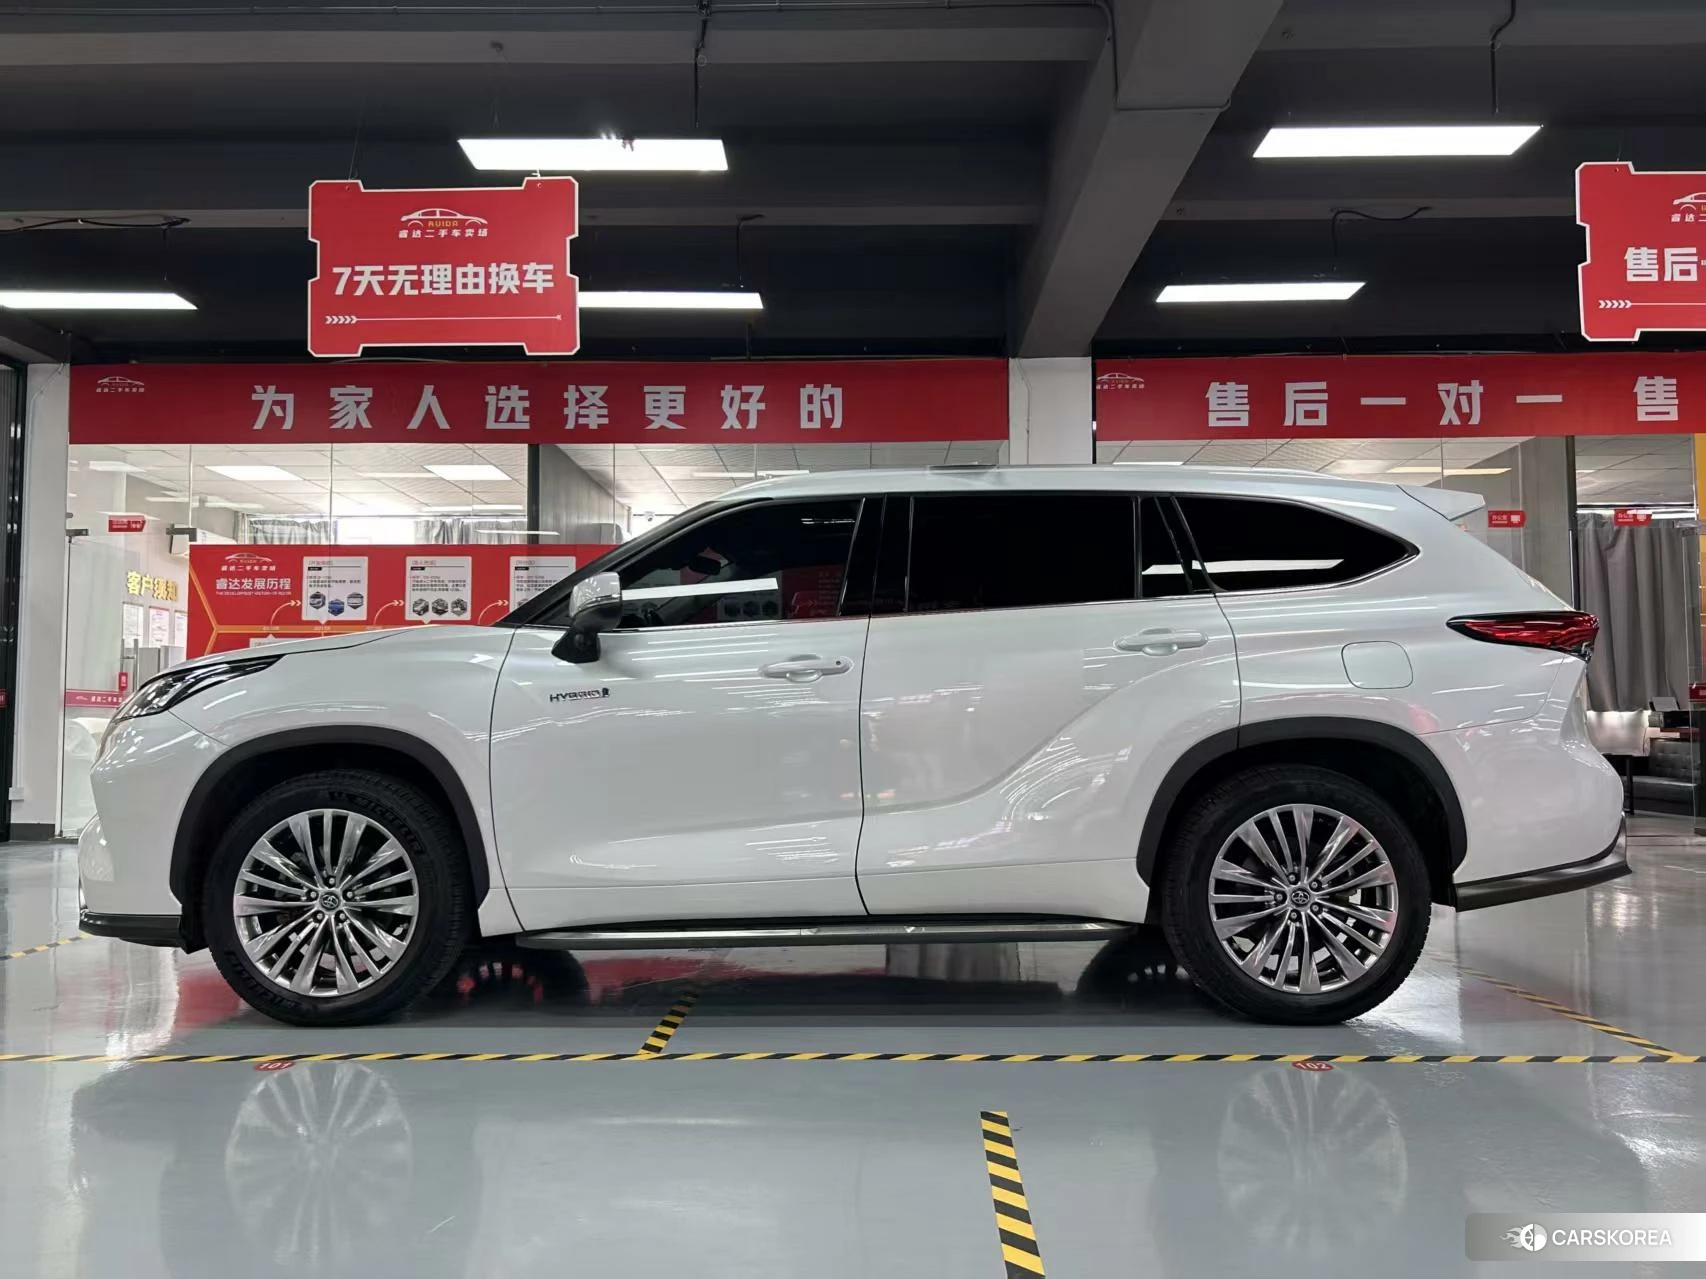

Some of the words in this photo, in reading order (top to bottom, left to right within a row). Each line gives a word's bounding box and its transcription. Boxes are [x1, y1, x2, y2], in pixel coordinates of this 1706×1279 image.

[332, 262, 554, 296] 7天无理由换车
[252, 384, 843, 430] 为家人选择更好的
[215, 578, 291, 590] 睿达发展历程
